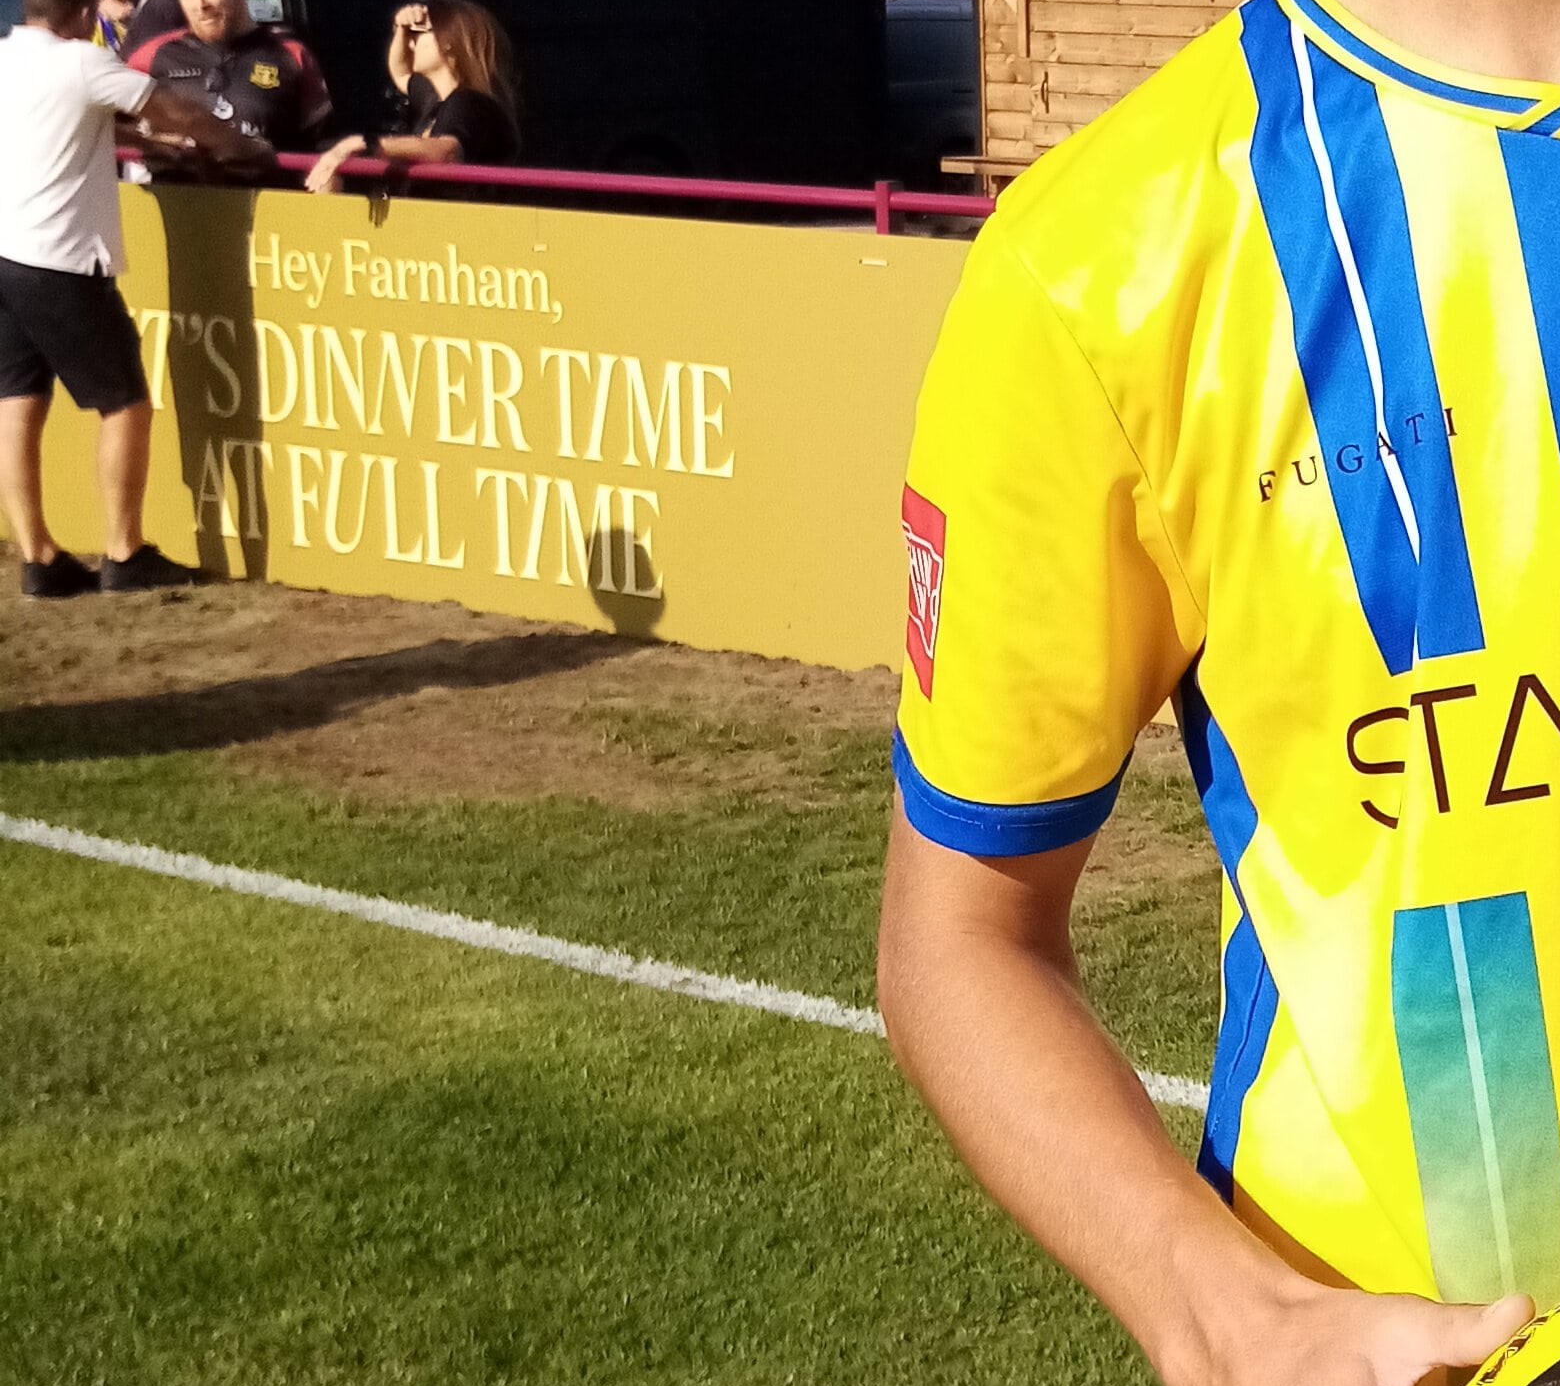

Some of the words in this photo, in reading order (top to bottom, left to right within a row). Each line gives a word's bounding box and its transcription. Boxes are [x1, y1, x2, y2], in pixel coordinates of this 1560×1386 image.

[248, 231, 332, 308] Hey
[343, 238, 562, 324] Farnham,
[254, 318, 531, 452] DINNER
[540, 346, 735, 478] TIME
[1259, 408, 1458, 502] FUGATI
[193, 436, 274, 539] AT
[286, 443, 465, 569] FULL
[476, 466, 663, 599] TIME
